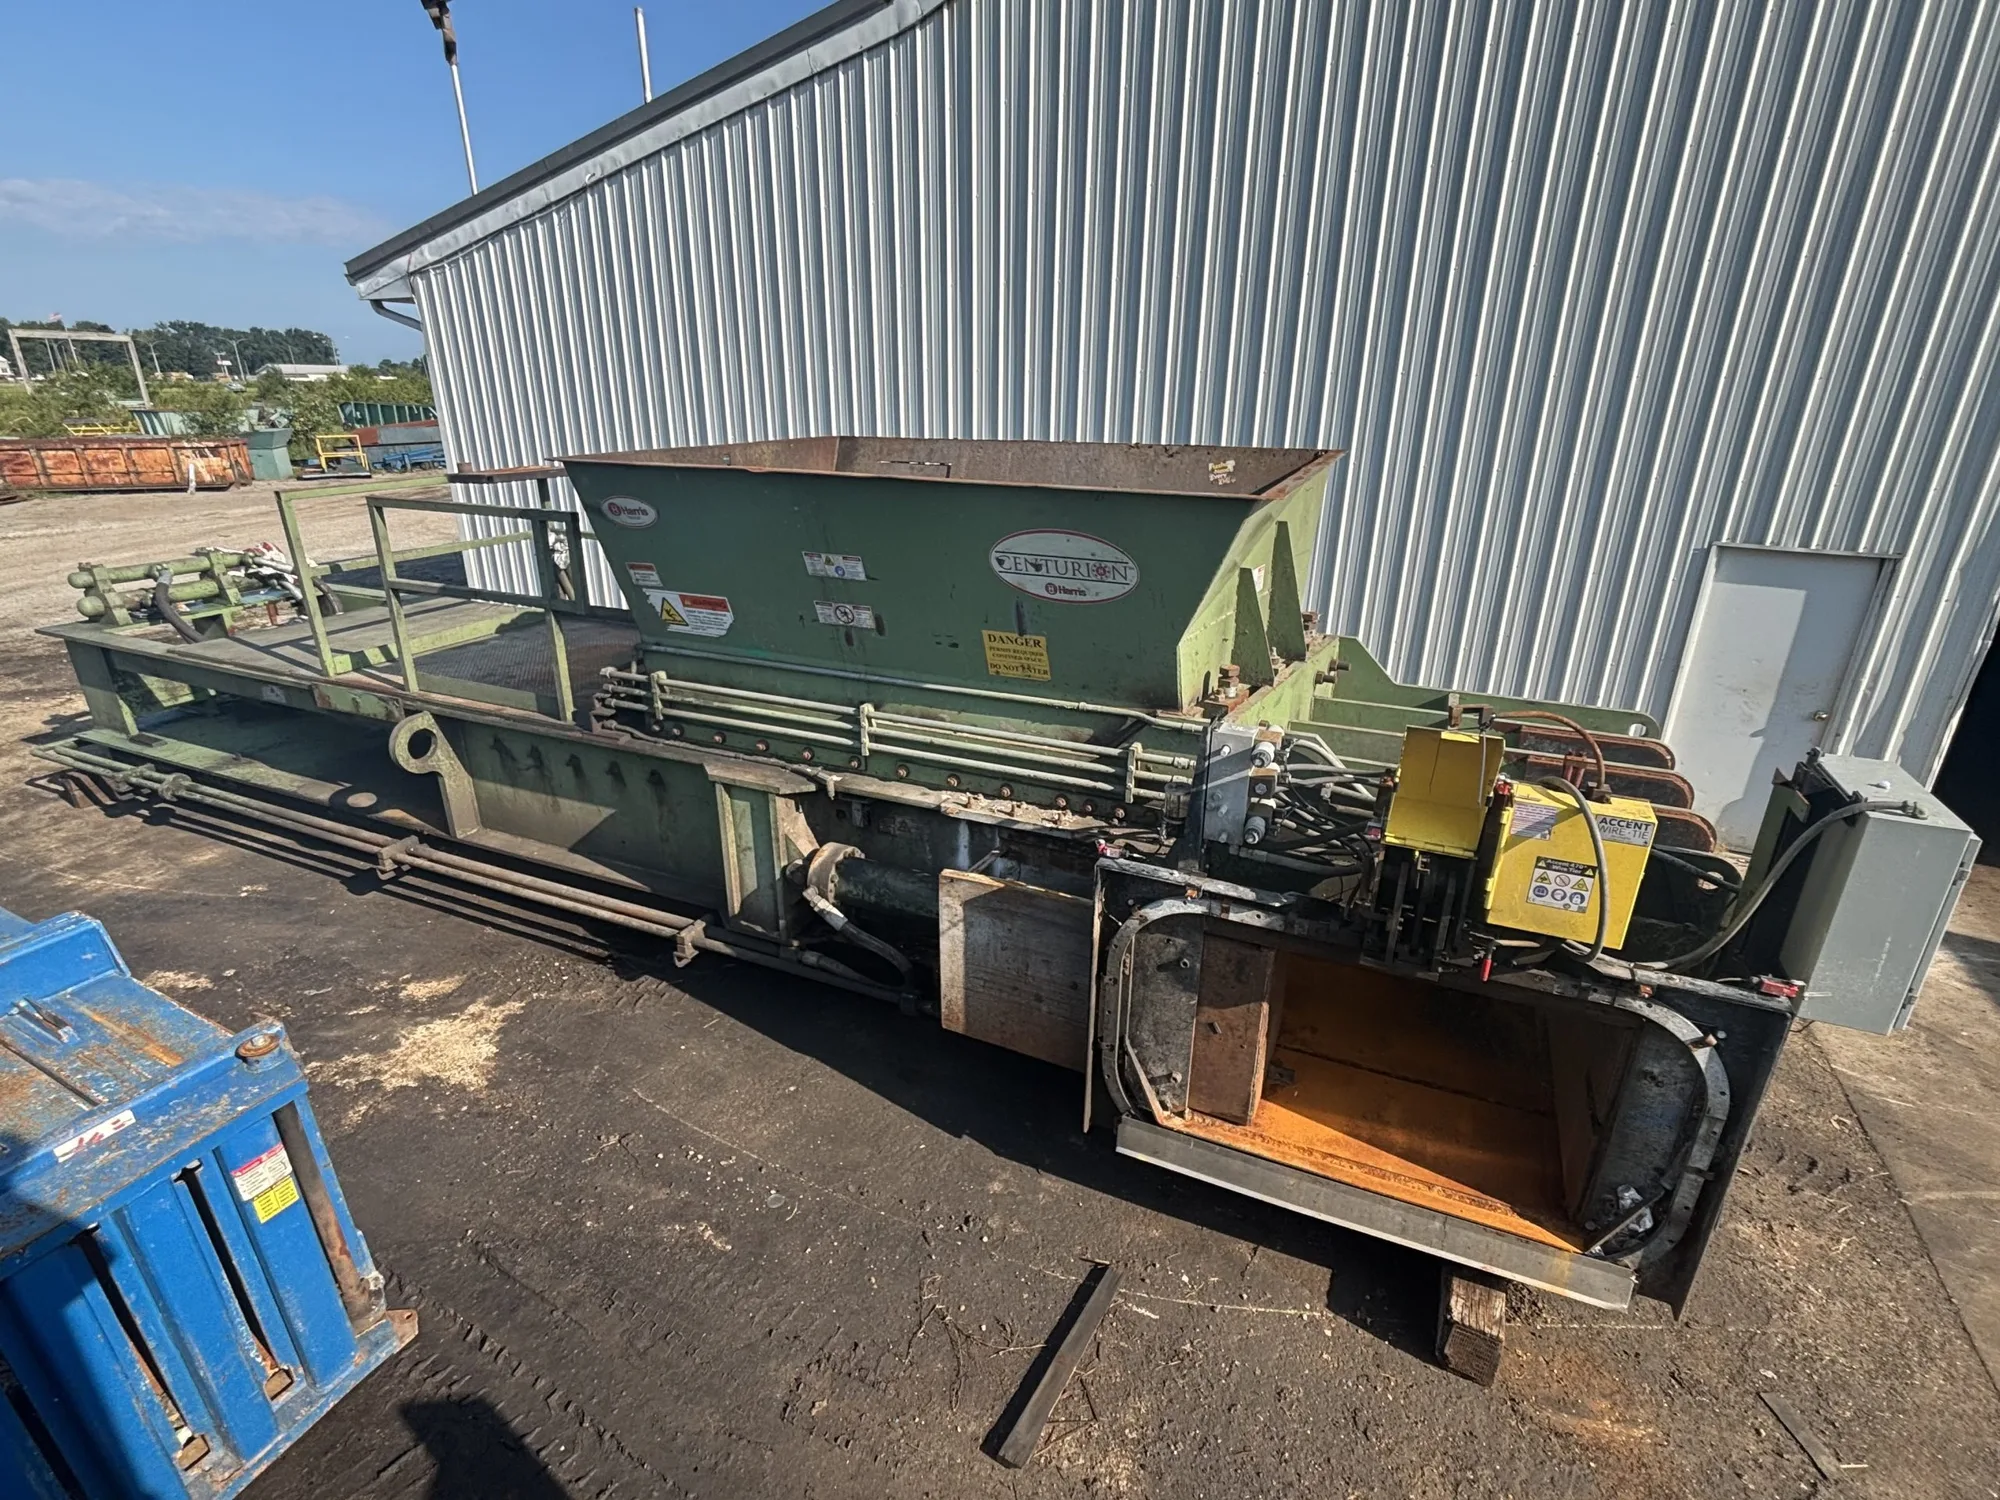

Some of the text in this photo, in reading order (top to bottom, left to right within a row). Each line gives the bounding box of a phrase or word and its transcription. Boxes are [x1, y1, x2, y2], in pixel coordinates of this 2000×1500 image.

[621, 506, 649, 516] Harris
[995, 555, 1128, 581] CENTURION
[1058, 585, 1087, 596] Harris
[988, 633, 1042, 648] DANGER
[990, 662, 1048, 675] DO NOT ENTER
[1600, 817, 1651, 831] ACCENT
[1598, 824, 1625, 836] WIRE
[1632, 829, 1649, 840] TIE
[1546, 859, 1569, 867] Accent
[1552, 865, 1568, 873] Wire
